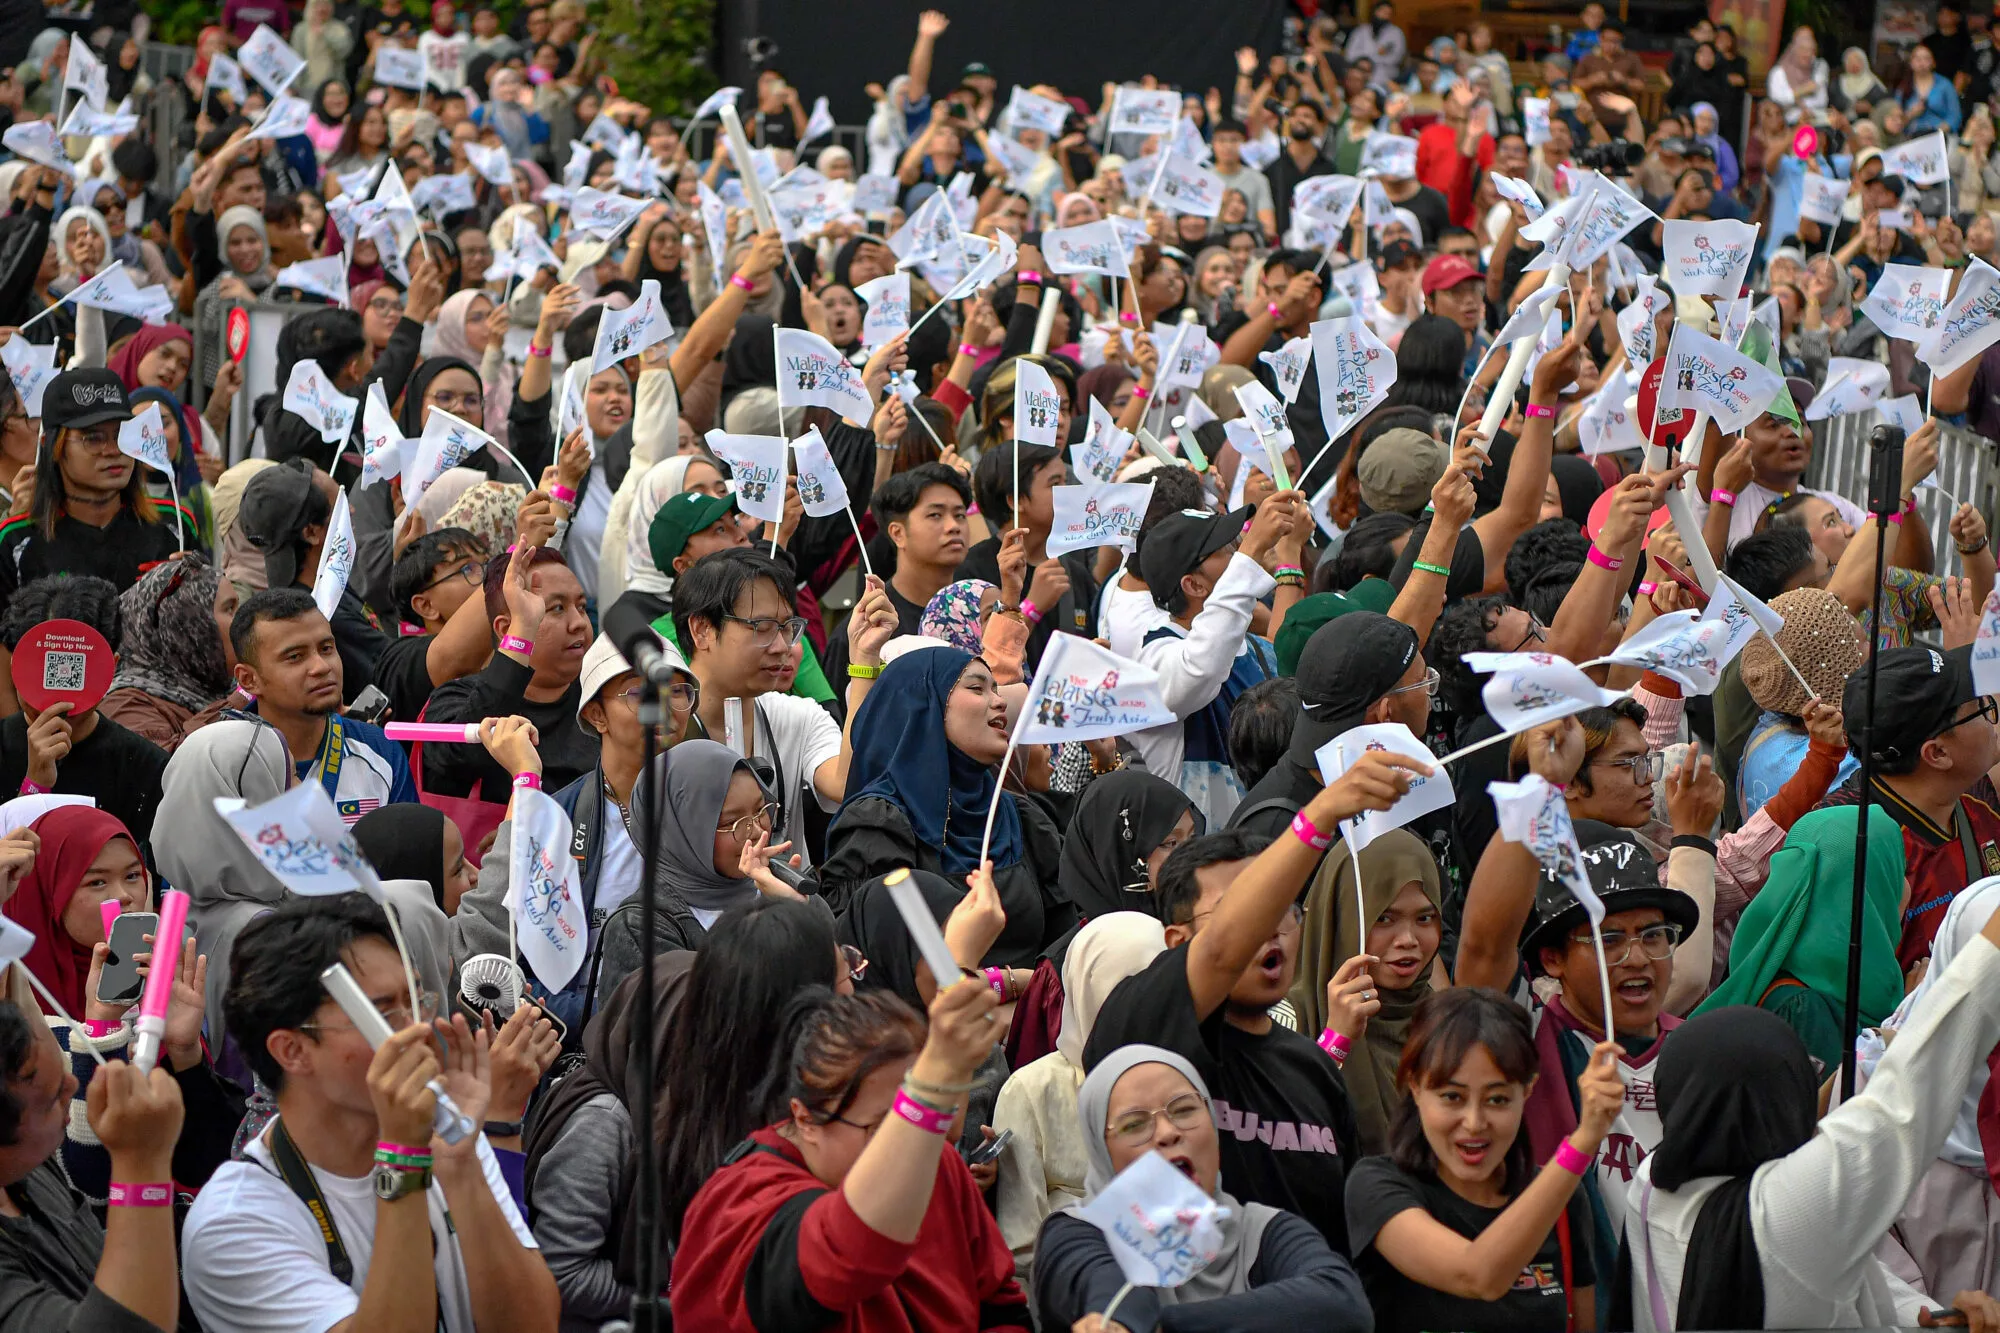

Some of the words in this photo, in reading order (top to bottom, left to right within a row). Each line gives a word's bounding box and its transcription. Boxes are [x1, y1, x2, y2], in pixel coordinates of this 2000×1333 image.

[1733, 385, 1751, 404] 2026
[43, 641, 61, 651] Sign
[63, 642, 75, 652] Up
[76, 643, 94, 652] Now
[45, 633, 86, 643] Download
[1073, 706, 1117, 729] Truly
[326, 724, 343, 775] IKEA
[542, 924, 568, 952] Asia
[557, 916, 577, 940] 2026
